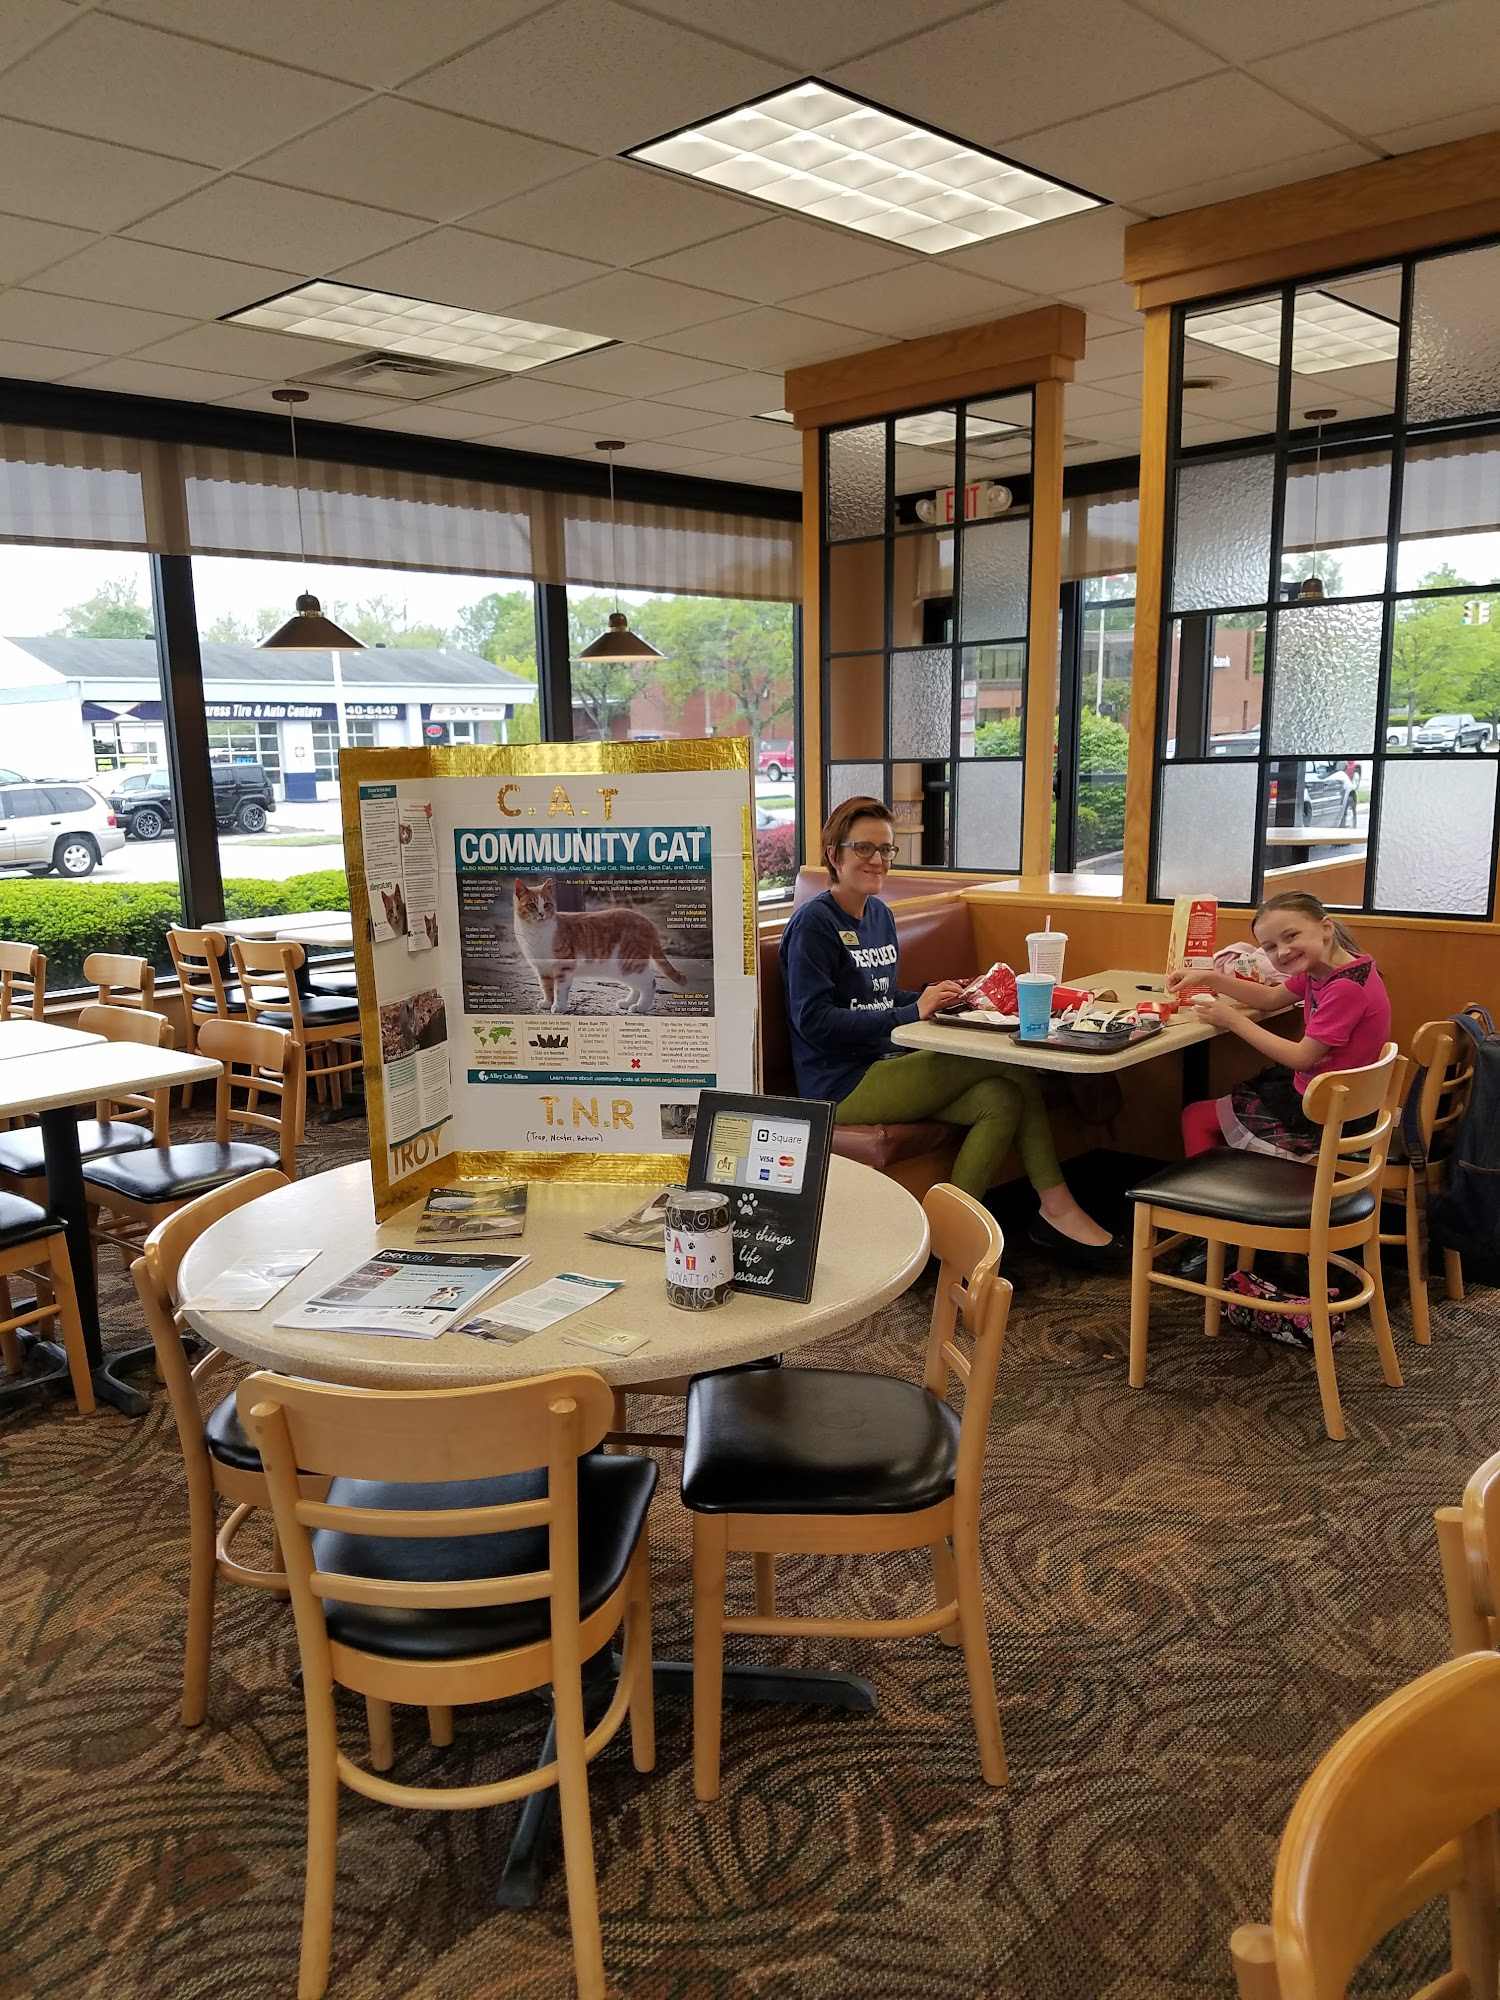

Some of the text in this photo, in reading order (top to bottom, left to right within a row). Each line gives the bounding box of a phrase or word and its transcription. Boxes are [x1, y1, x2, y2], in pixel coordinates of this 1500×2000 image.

[945, 485, 979, 523] EIT
[233, 704, 253, 718] Tire
[254, 704, 262, 718] &
[263, 705, 286, 718] Auto
[287, 705, 322, 718] Centers
[460, 833, 641, 863] COMMUNITY
[649, 832, 705, 862] CAT
[871, 974, 890, 994] is my
[772, 1132, 802, 1144] Square
[390, 1126, 442, 1175] TROY
[717, 1156, 732, 1170] CAT
[673, 1236, 684, 1254] A
[756, 1225, 795, 1252] things
[687, 1256, 695, 1270] T
[739, 1244, 762, 1268] life
[670, 1270, 725, 1285] ONATIONS
[734, 1268, 774, 1286] escued
